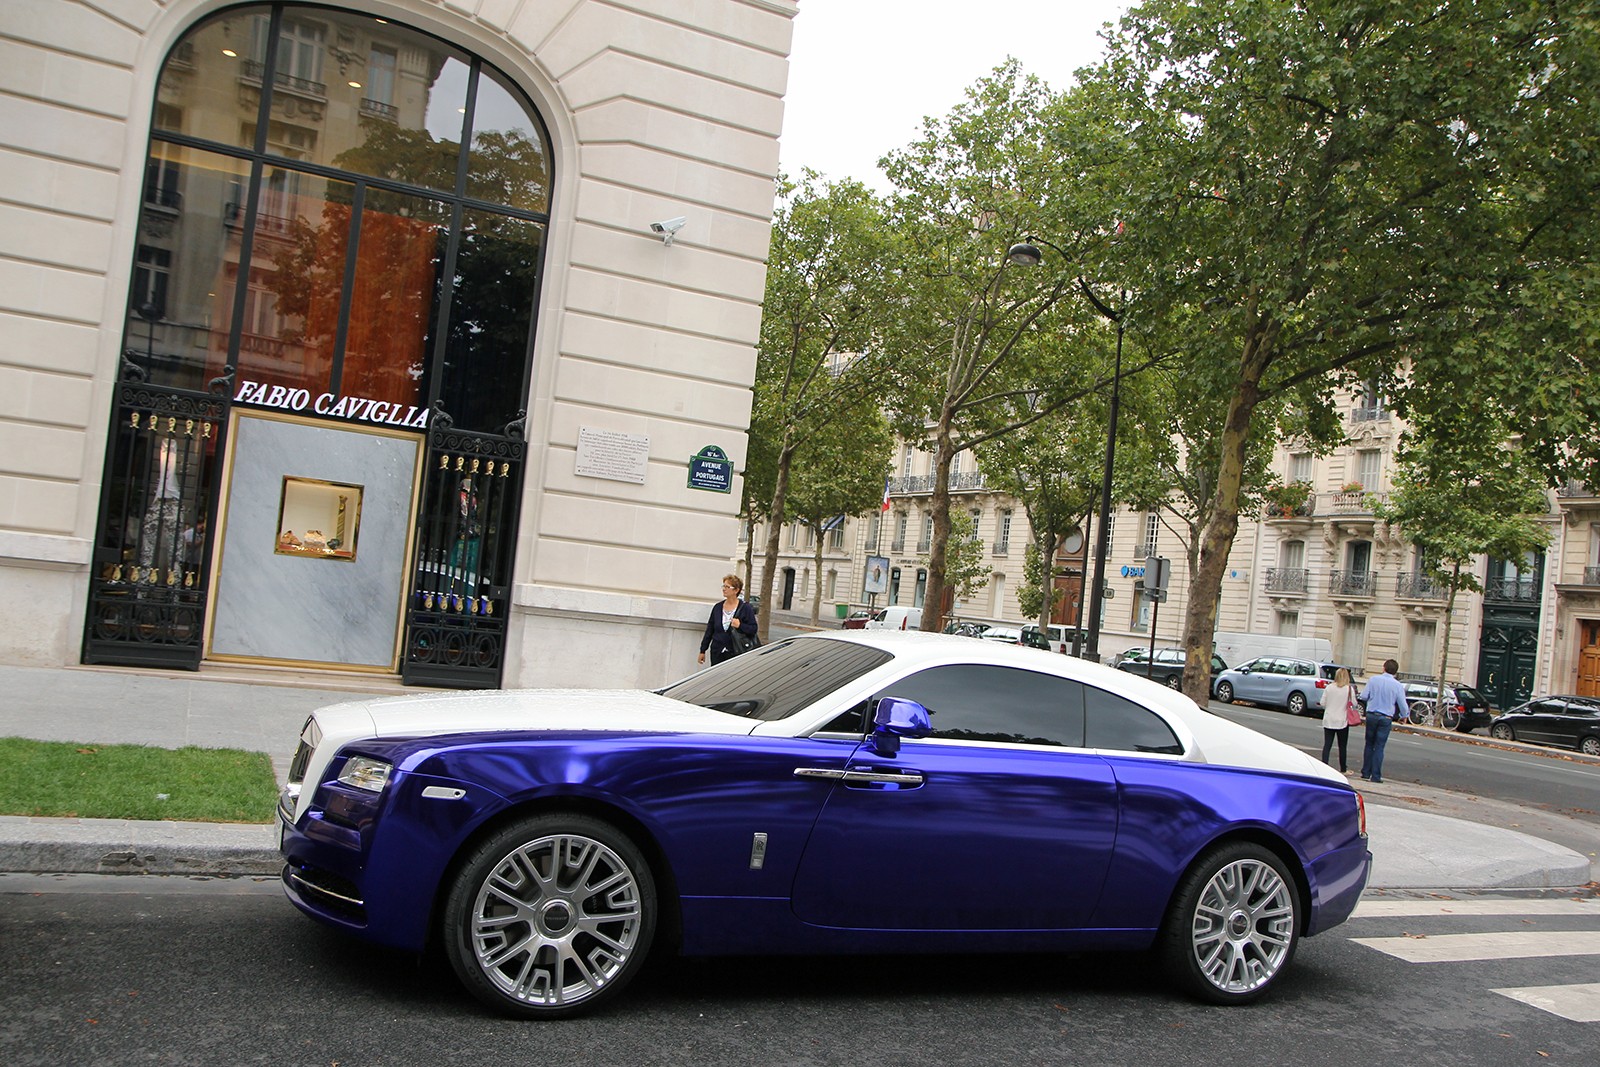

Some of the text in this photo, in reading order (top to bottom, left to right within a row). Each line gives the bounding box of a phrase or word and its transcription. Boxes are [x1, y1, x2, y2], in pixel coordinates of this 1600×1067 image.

[233, 380, 430, 429] FABIO CAVIGLIA
[701, 461, 722, 470] AVENUE
[695, 472, 725, 481] PORTUGAIS
